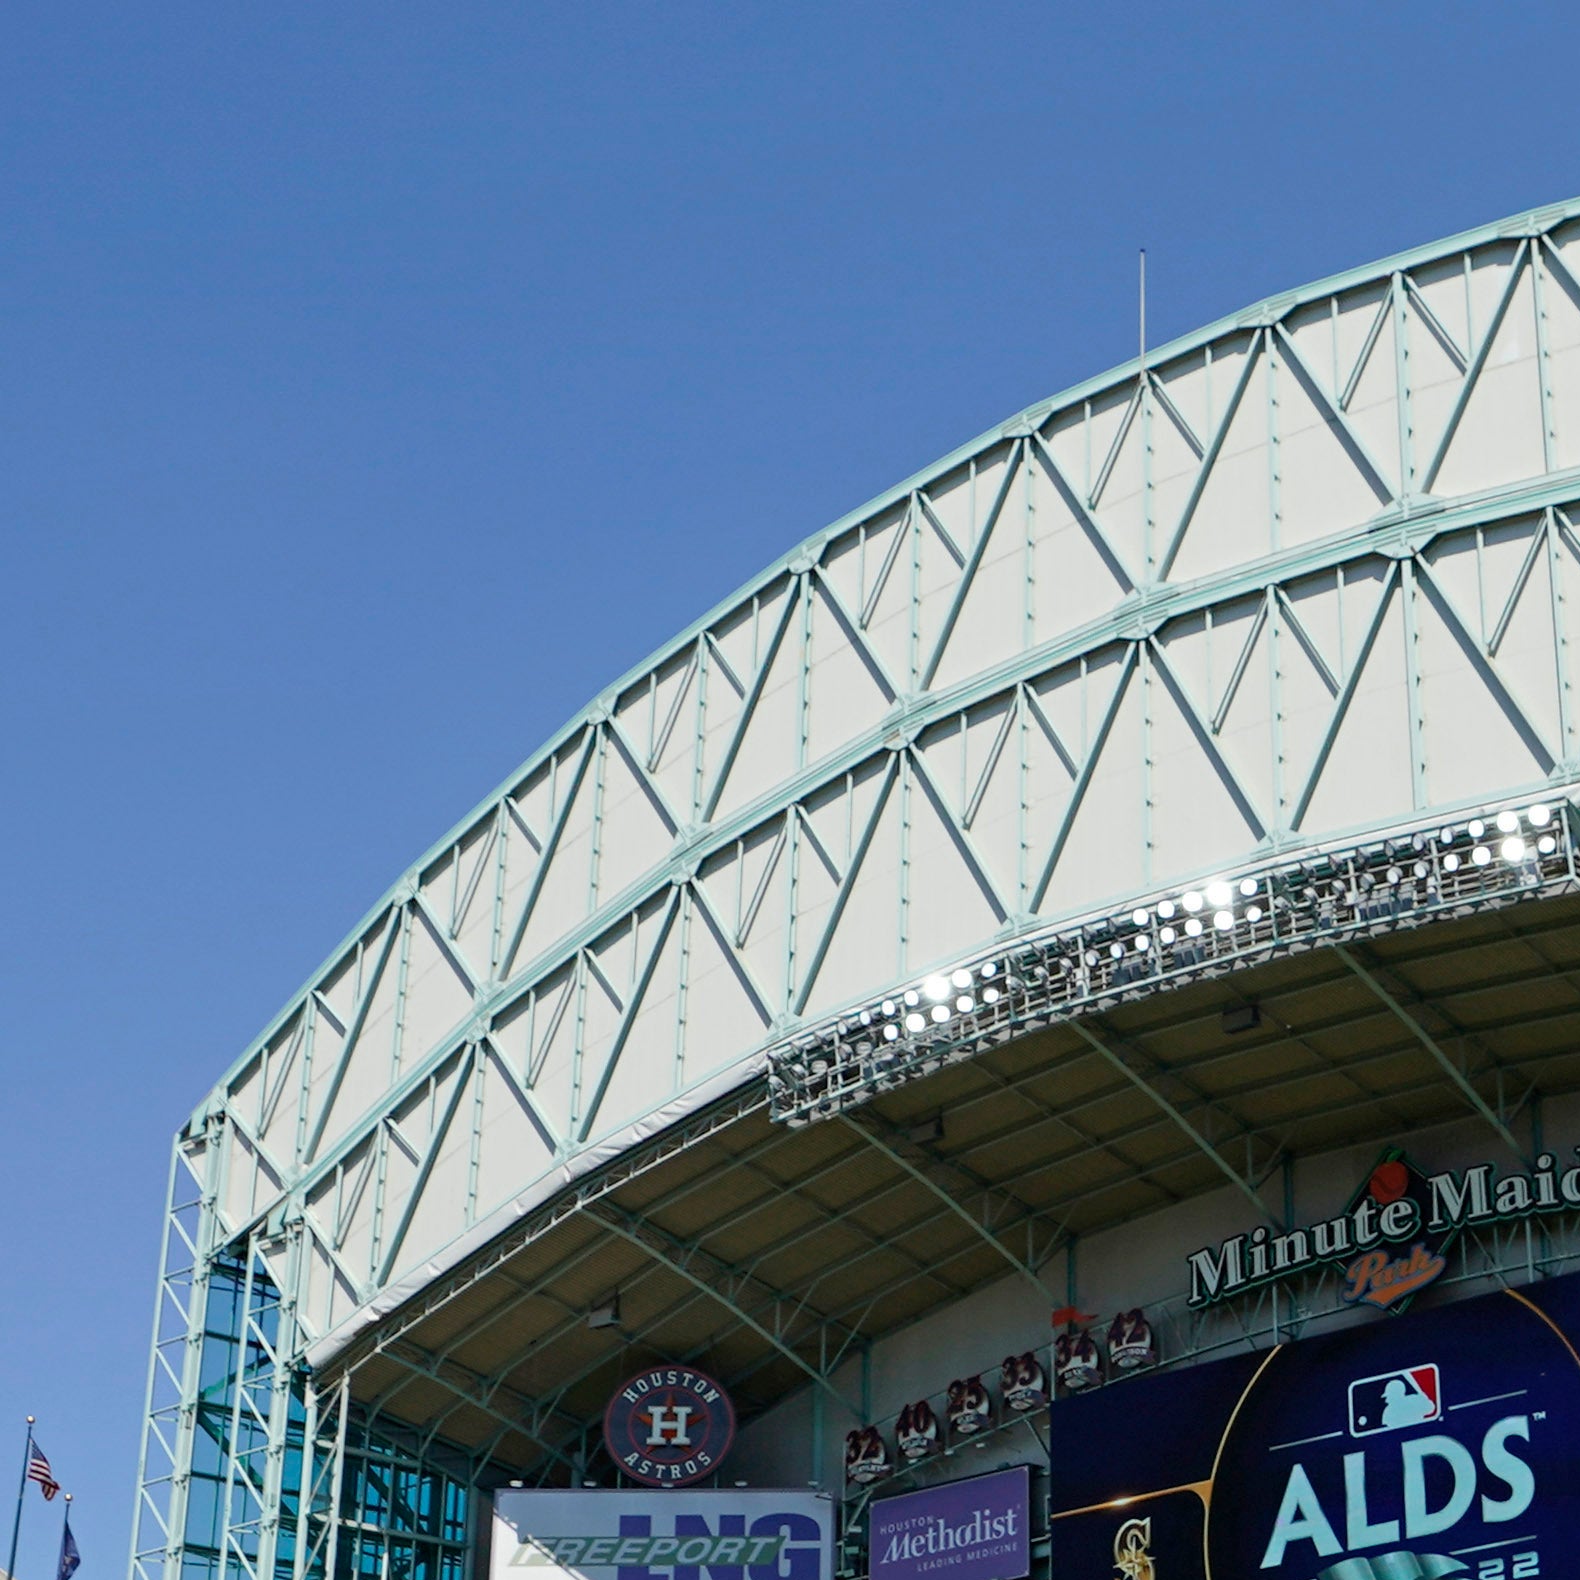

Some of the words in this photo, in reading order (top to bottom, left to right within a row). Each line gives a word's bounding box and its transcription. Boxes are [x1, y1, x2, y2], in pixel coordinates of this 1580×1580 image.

[1188, 1196, 1419, 1305] Minute
[1343, 1243, 1446, 1306] Park
[622, 1370, 721, 1404] HOUSTON
[623, 1451, 712, 1480] ASTROS
[1259, 1416, 1537, 1570] ALDS
[879, 1508, 1018, 1565] Methodist
[880, 1515, 935, 1535] HOUSTON
[517, 1536, 778, 1566] FREEPORT
[916, 1554, 962, 1572] LEADING
[966, 1542, 1018, 1560] MEDICINE
